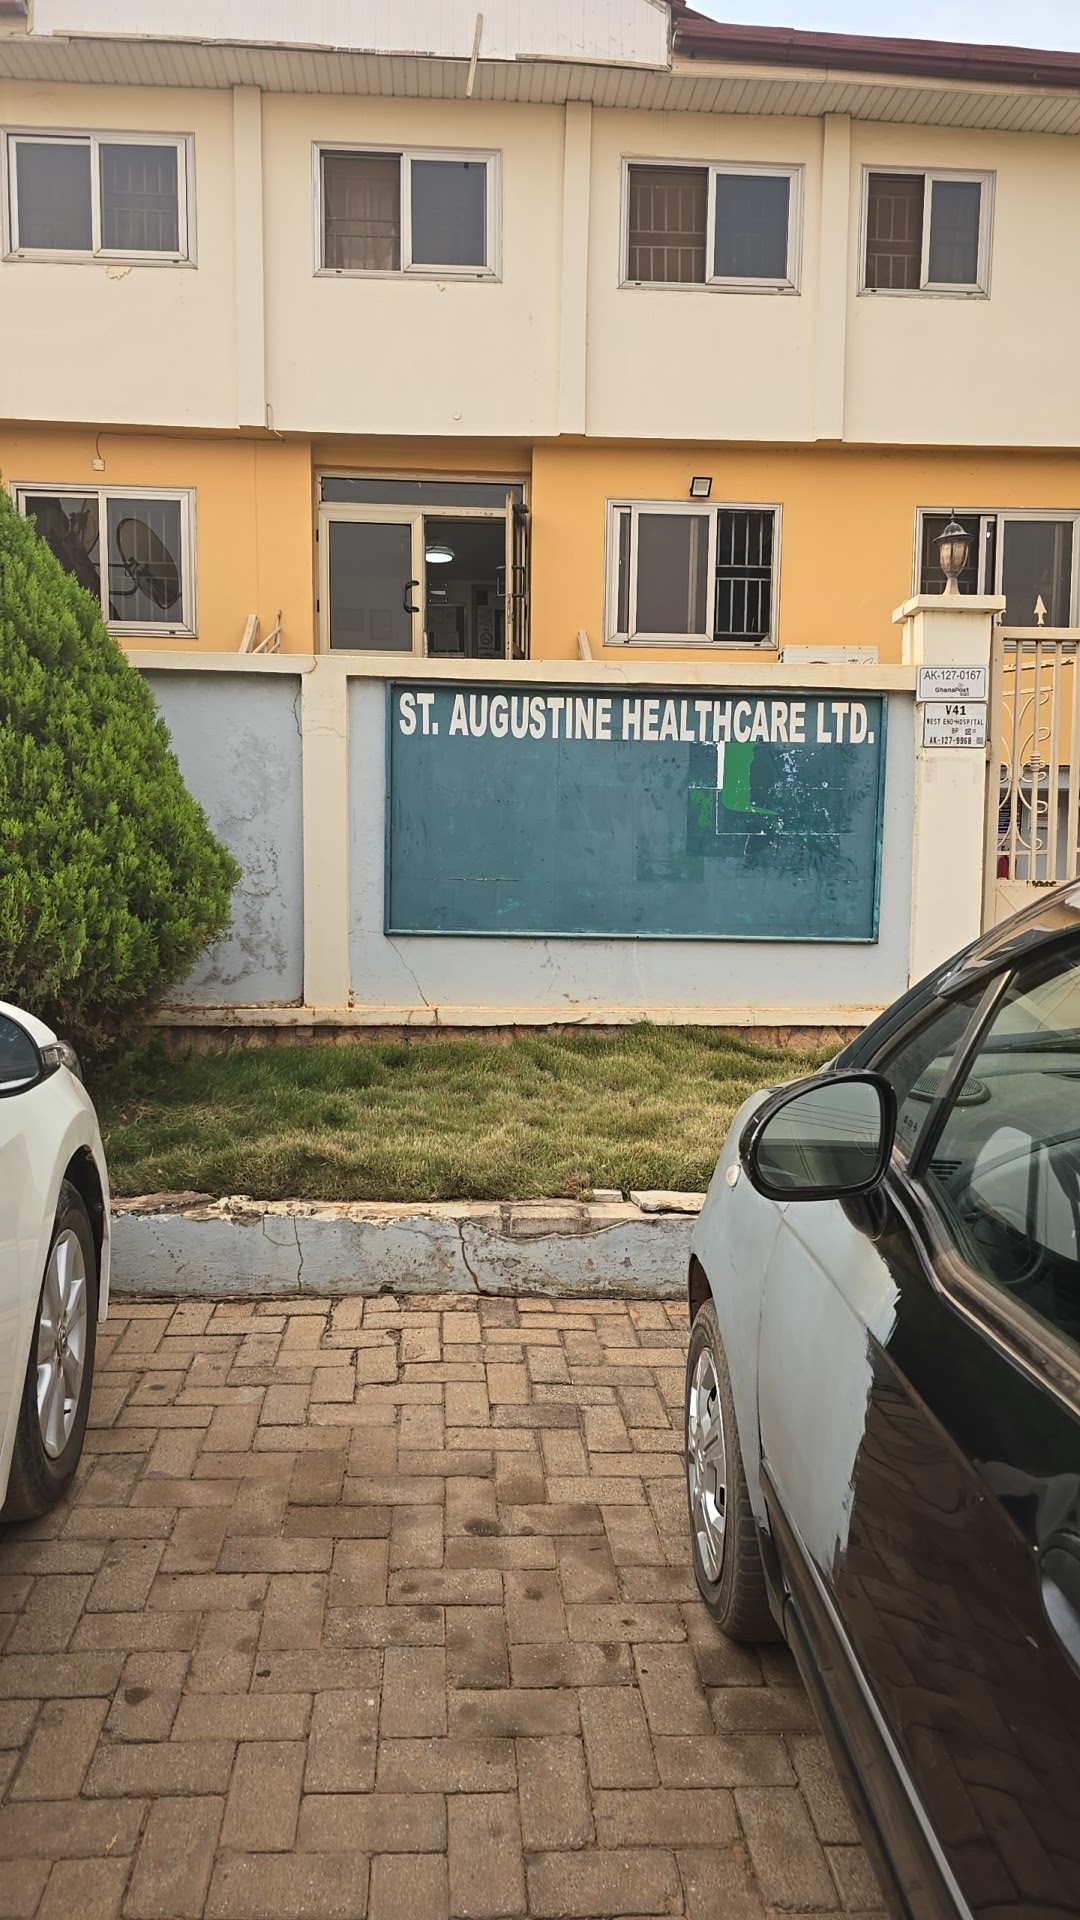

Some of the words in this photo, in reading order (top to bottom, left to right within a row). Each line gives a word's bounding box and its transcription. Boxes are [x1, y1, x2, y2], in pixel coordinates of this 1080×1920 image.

[924, 670, 982, 680] AK-127-0167
[946, 705, 966, 716] V41
[399, 692, 439, 736] ST.
[449, 694, 612, 740] AUGUSTINE
[622, 698, 806, 743] HEALTHCARE
[816, 702, 875, 744] LTD.
